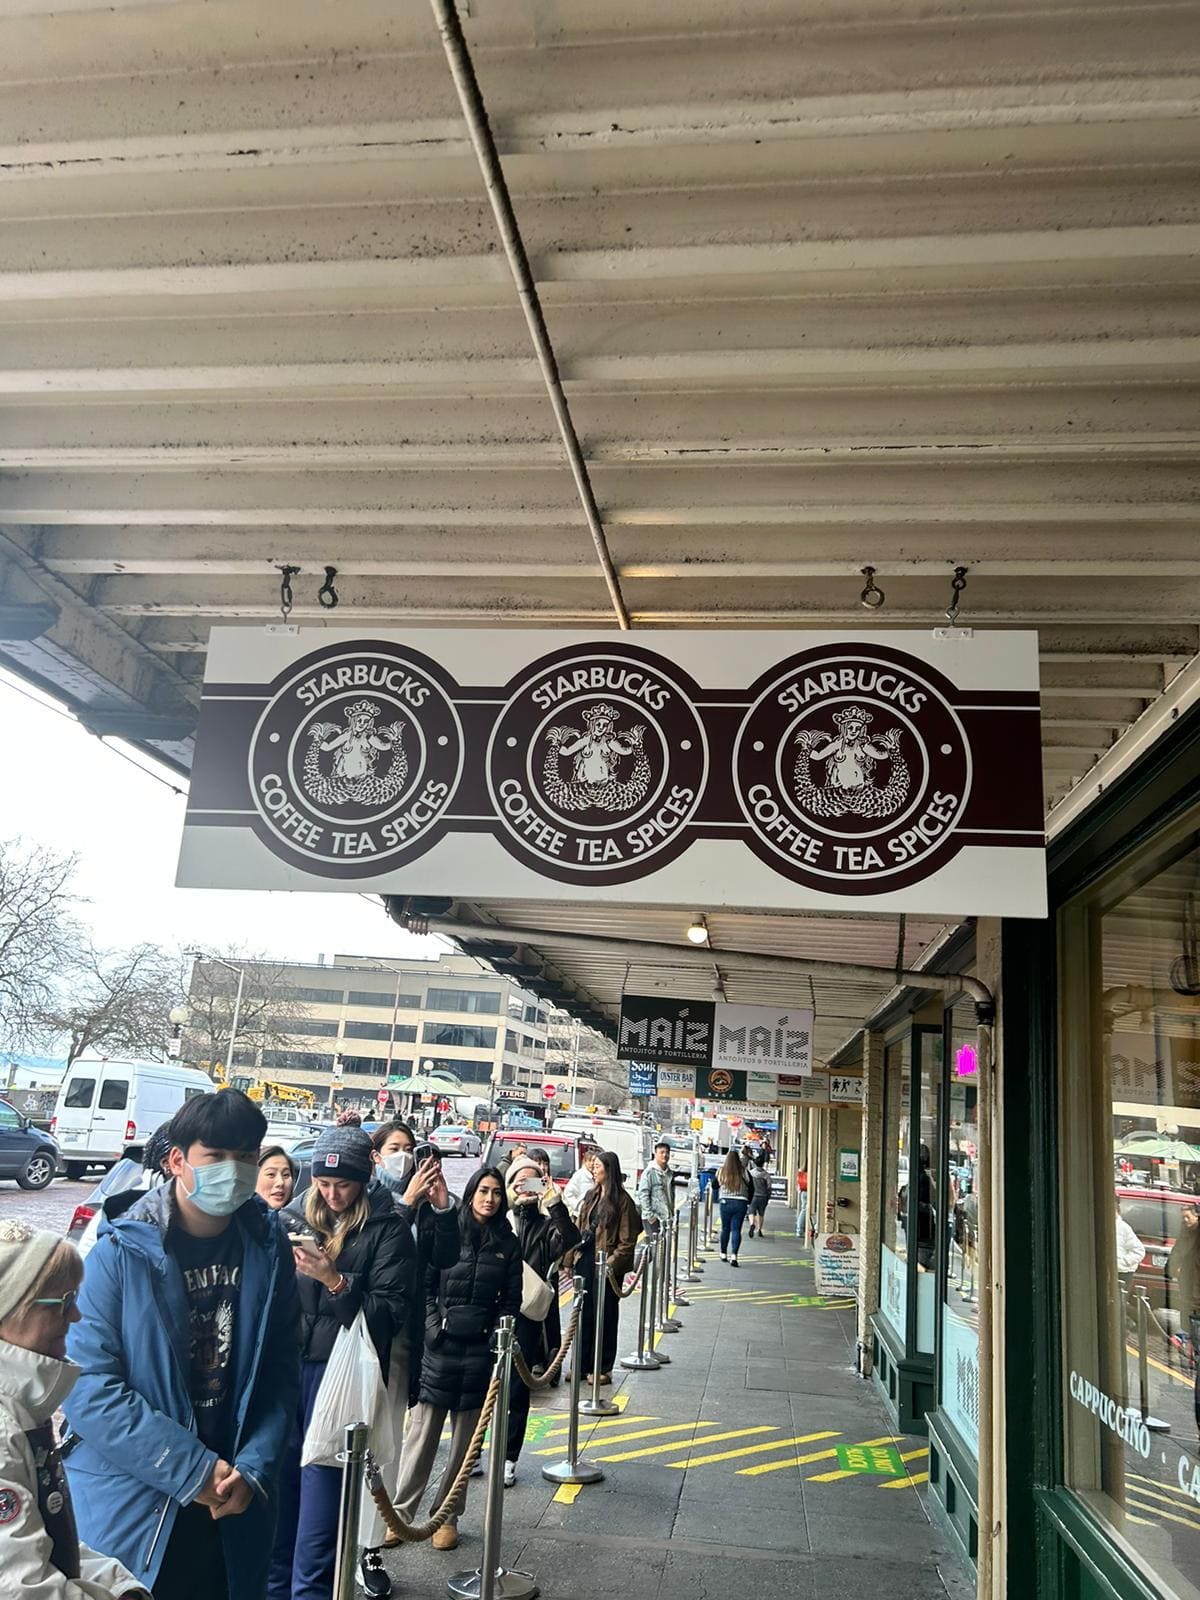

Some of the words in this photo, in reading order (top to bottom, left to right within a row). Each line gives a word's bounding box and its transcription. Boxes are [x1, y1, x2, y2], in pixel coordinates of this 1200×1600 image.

[296, 664, 431, 707] STARBUCKS
[531, 667, 671, 711] STARBUCKS
[777, 668, 928, 714] STARBUCKS
[259, 773, 322, 849] COFFEE
[331, 831, 377, 855] TEA
[385, 779, 448, 848] SPICES
[499, 778, 568, 855] COFFEE
[575, 838, 624, 862] TEA
[626, 785, 694, 853] SPICES
[747, 784, 825, 864] COFFEE
[832, 845, 885, 871] TEA
[886, 790, 958, 863] SPICES
[620, 1007, 709, 1051] MAÍZ
[719, 1015, 809, 1060] MAÍZ
[620, 1046, 658, 1055] ANTOJITOS
[664, 1050, 707, 1059] TORTILLERIA
[630, 1060, 656, 1072] Souk
[718, 1055, 756, 1064] ANTOJITOS
[764, 1059, 808, 1068] TORTILLERIA
[660, 1072, 680, 1082] OYSTER
[681, 1073, 694, 1082] BAR
[1070, 1370, 1150, 1458] CAPPUCCINO
